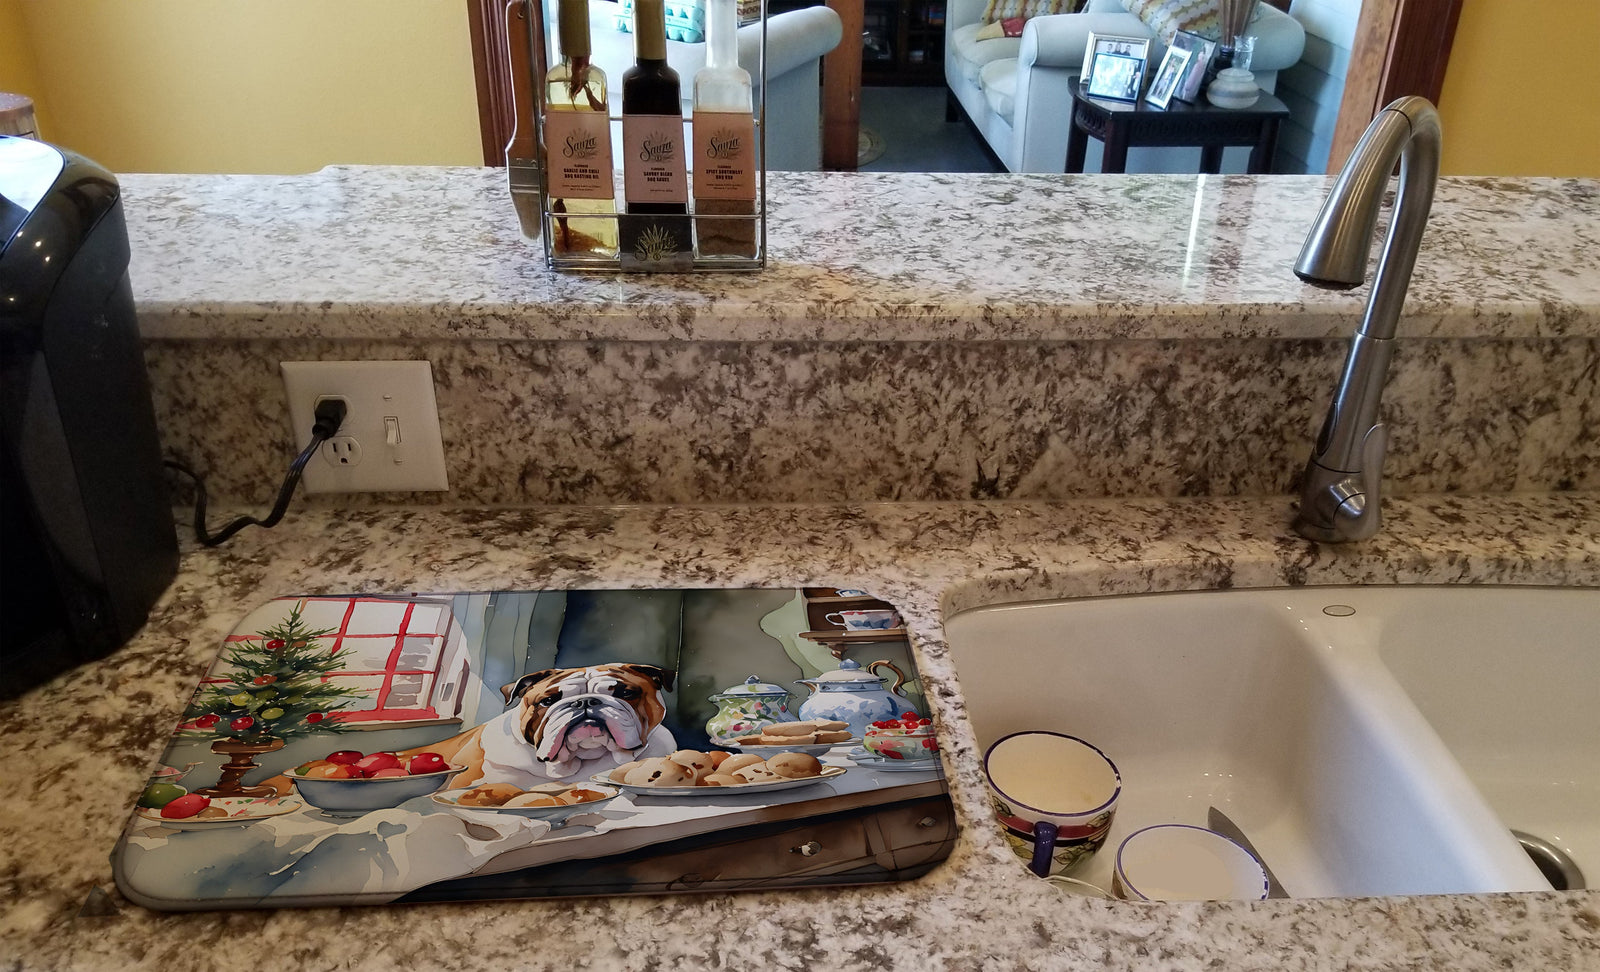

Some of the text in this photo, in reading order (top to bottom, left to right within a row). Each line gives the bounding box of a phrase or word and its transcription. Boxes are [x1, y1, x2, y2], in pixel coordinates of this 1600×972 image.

[563, 136, 597, 158] Sauza
[640, 140, 673, 162] Sauza
[707, 137, 739, 159] Sauza
